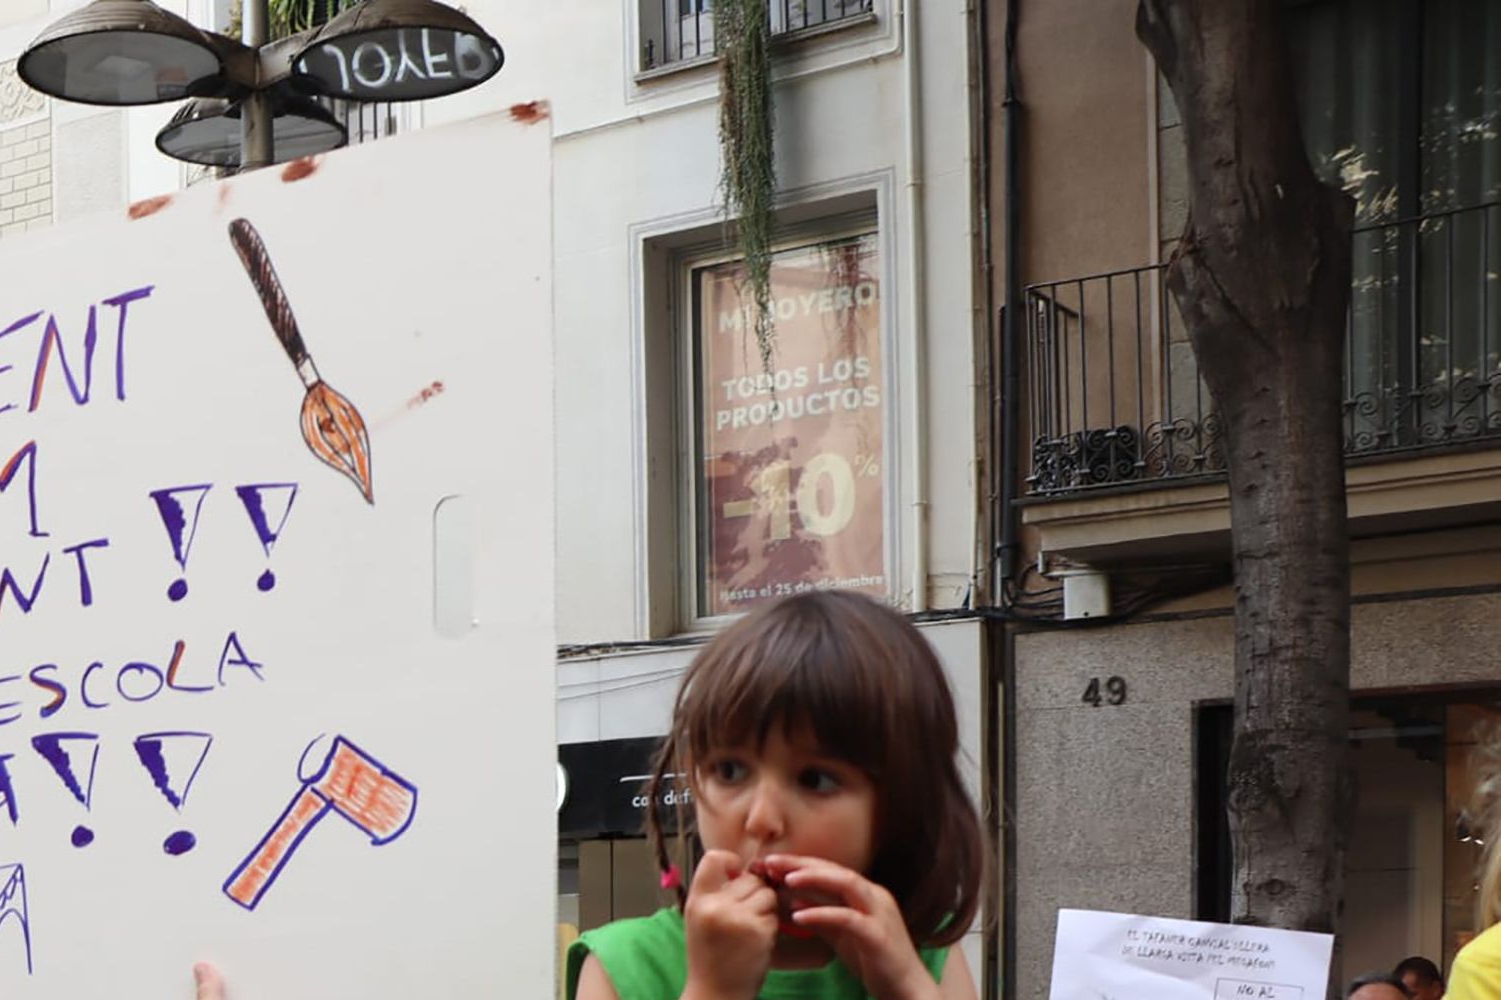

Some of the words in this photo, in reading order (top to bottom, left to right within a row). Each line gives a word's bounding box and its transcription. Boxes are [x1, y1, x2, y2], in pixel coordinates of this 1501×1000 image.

[722, 366, 809, 400] TODOS
[817, 356, 872, 384] LOS
[716, 385, 881, 430] PRODUCTOS
[760, 584, 772, 597] el
[775, 582, 793, 595] 25
[796, 580, 813, 592] de
[815, 574, 884, 591] diciembre
[1081, 675, 1127, 707] 49
[1237, 984, 1254, 997] NO
[1259, 986, 1276, 998] AL
